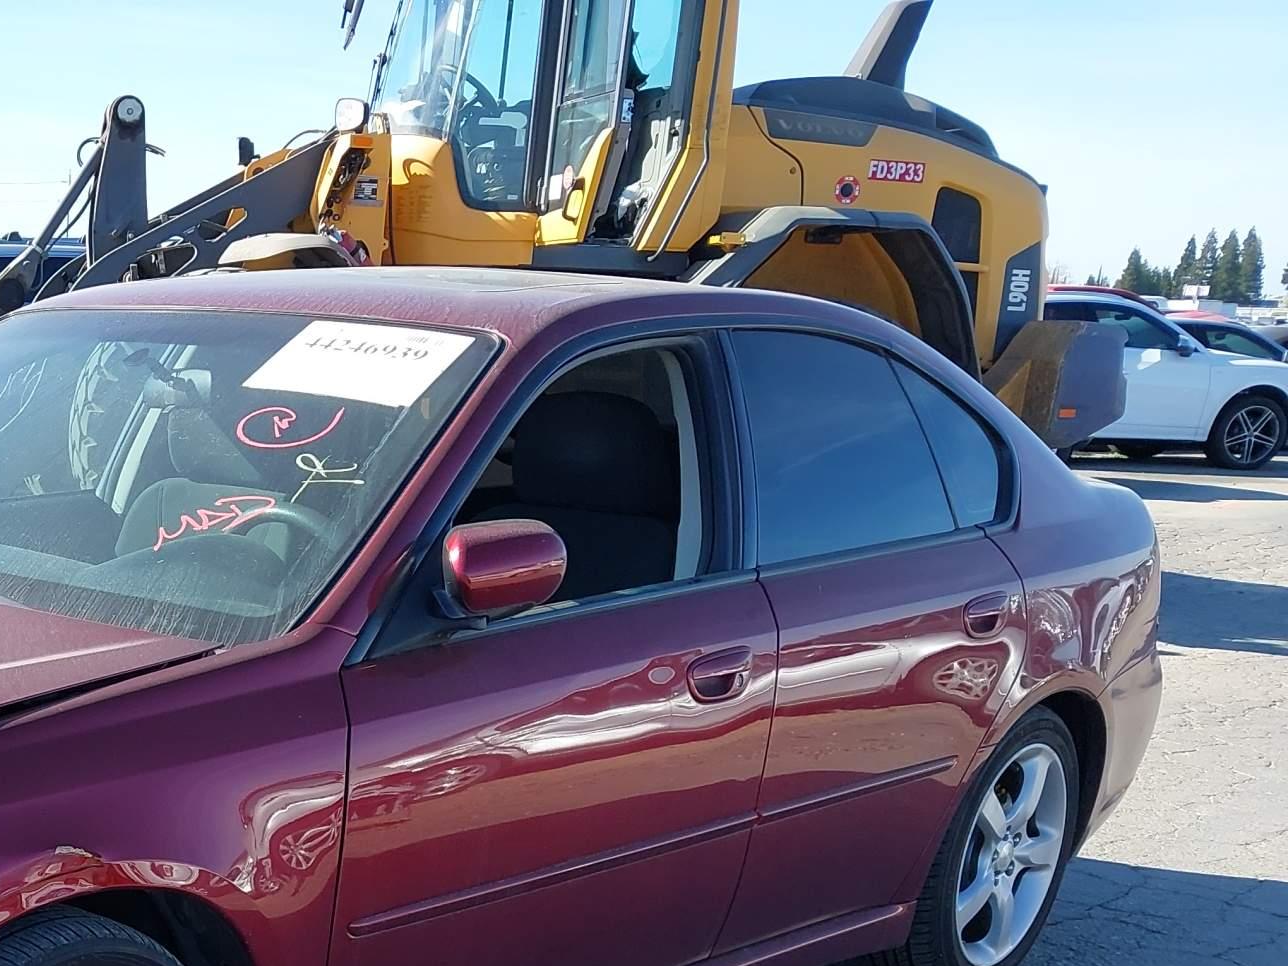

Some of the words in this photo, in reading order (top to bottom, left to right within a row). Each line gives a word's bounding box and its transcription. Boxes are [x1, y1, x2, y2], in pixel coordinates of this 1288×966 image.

[777, 119, 863, 137] VOLVO
[868, 160, 924, 182] FD3P33
[1007, 269, 1031, 311] L90H
[305, 337, 429, 361] 44246939
